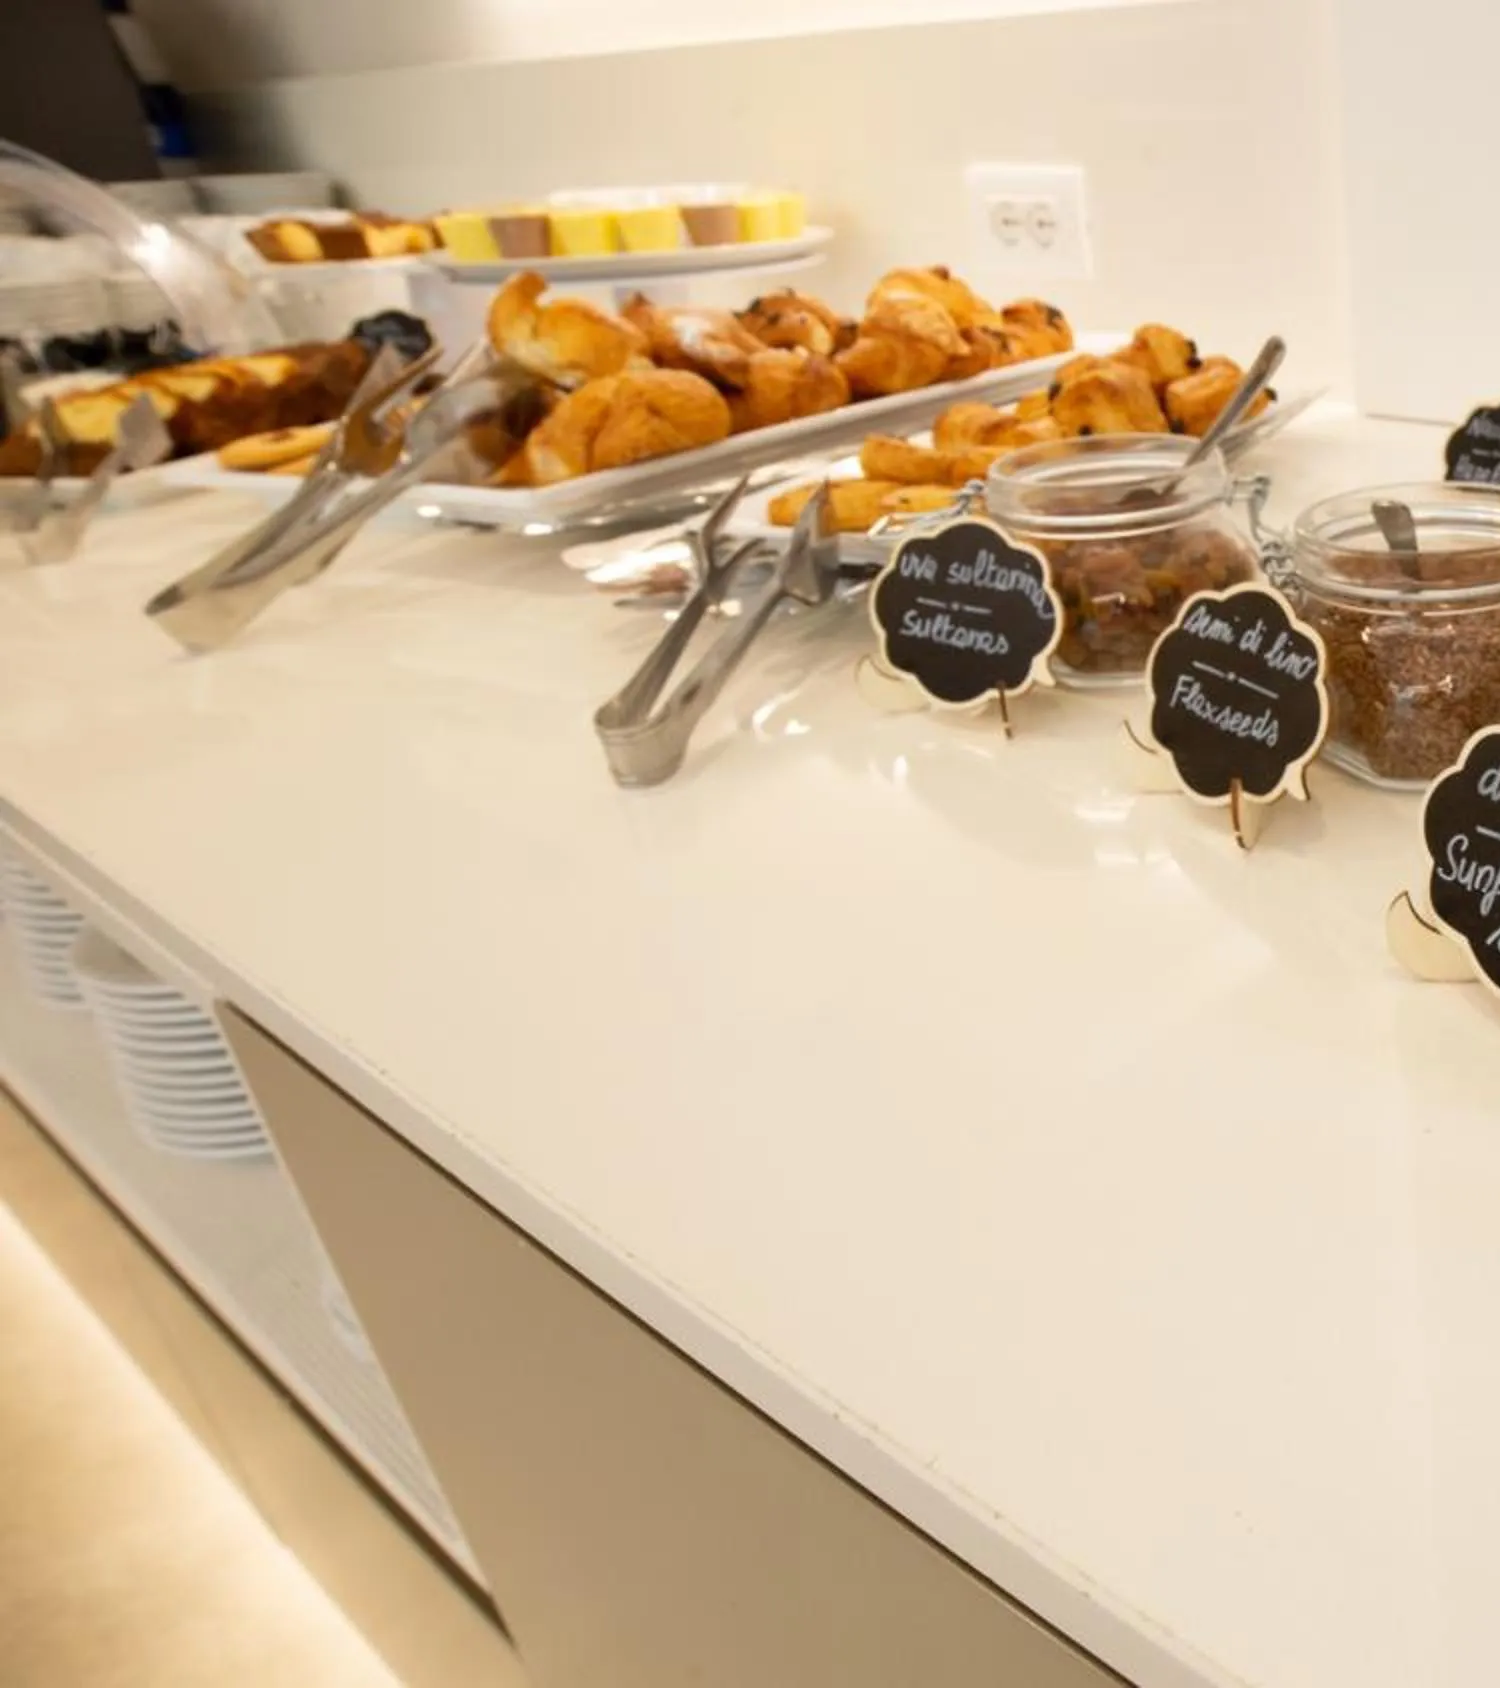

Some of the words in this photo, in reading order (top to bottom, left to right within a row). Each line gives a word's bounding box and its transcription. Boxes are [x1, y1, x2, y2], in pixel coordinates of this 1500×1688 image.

[1239, 619, 1267, 653] di
[1264, 632, 1317, 680] lino
[1169, 675, 1279, 748] Flaxseeds
